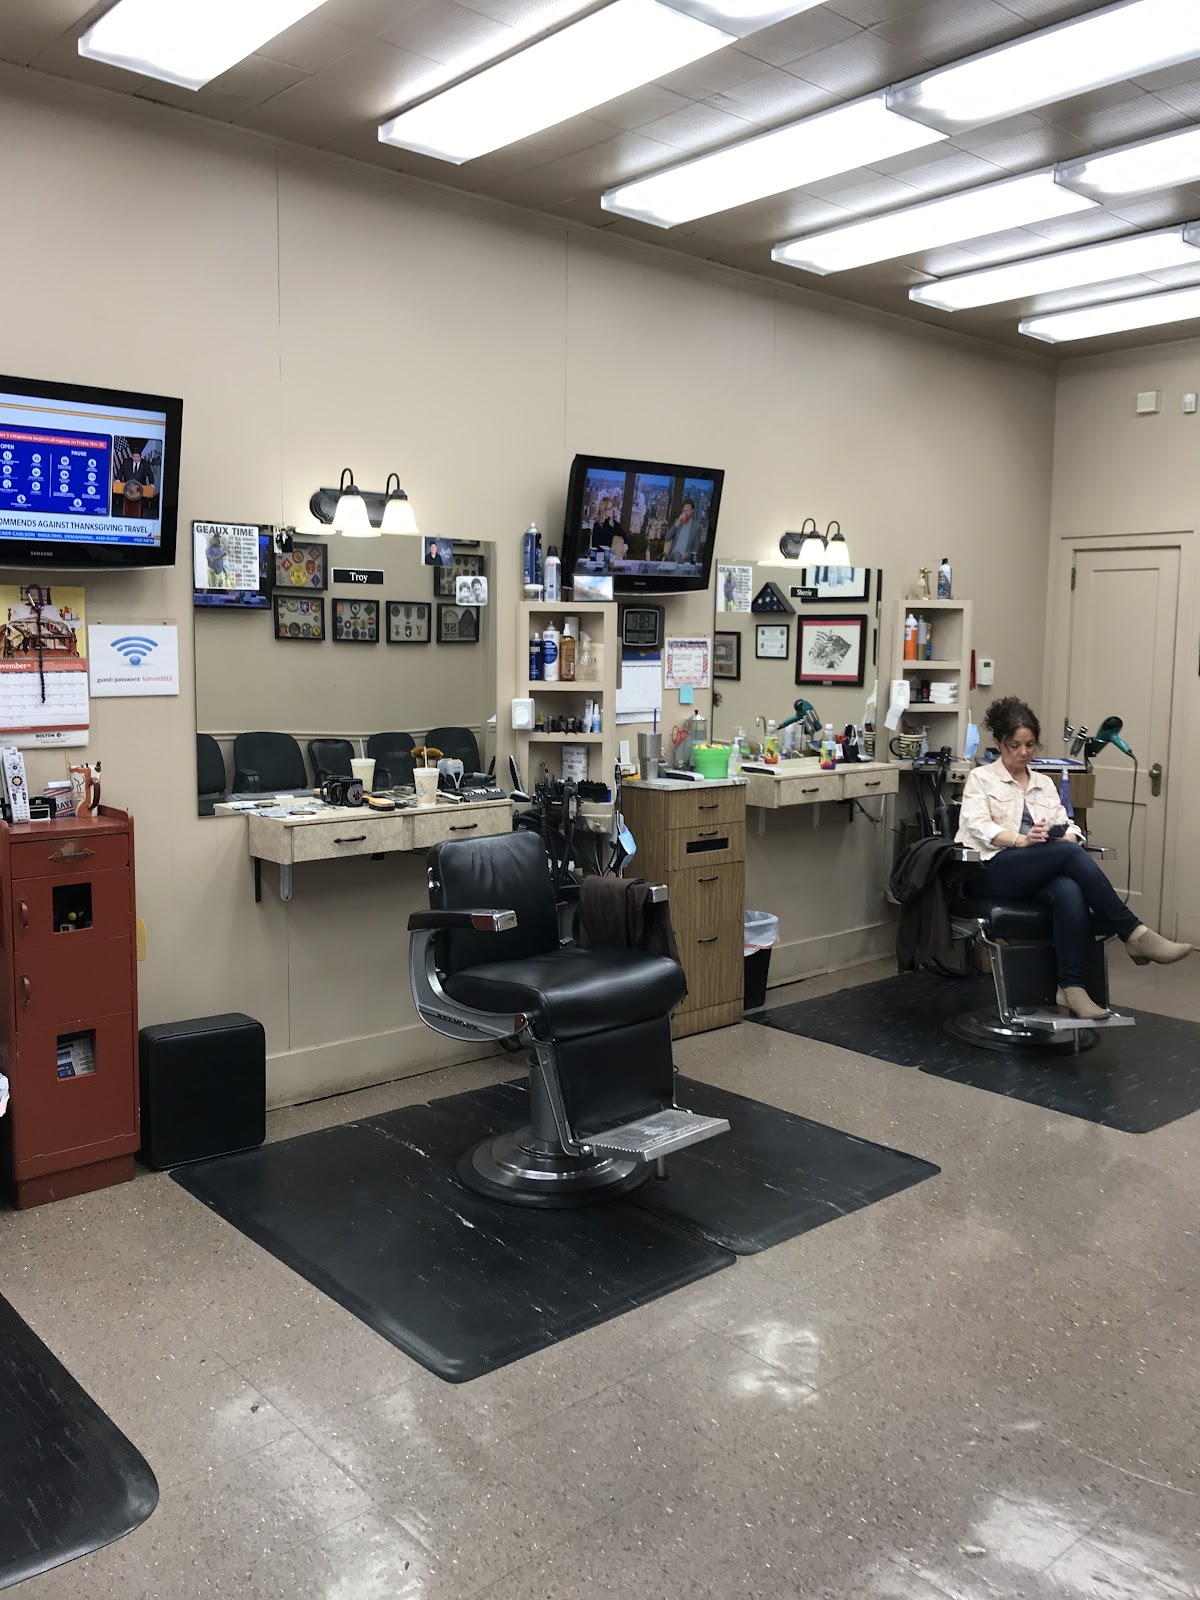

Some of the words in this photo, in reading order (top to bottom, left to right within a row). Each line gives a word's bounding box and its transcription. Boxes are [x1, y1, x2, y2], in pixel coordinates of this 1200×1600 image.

[38, 520, 69, 529] AGAINST
[71, 521, 123, 532] THANKSGIVING
[124, 525, 148, 533] TRAVEL
[196, 525, 228, 535] GEAUX
[232, 528, 254, 537] TIME
[719, 566, 736, 574] GEAUX
[349, 571, 368, 584] Troy
